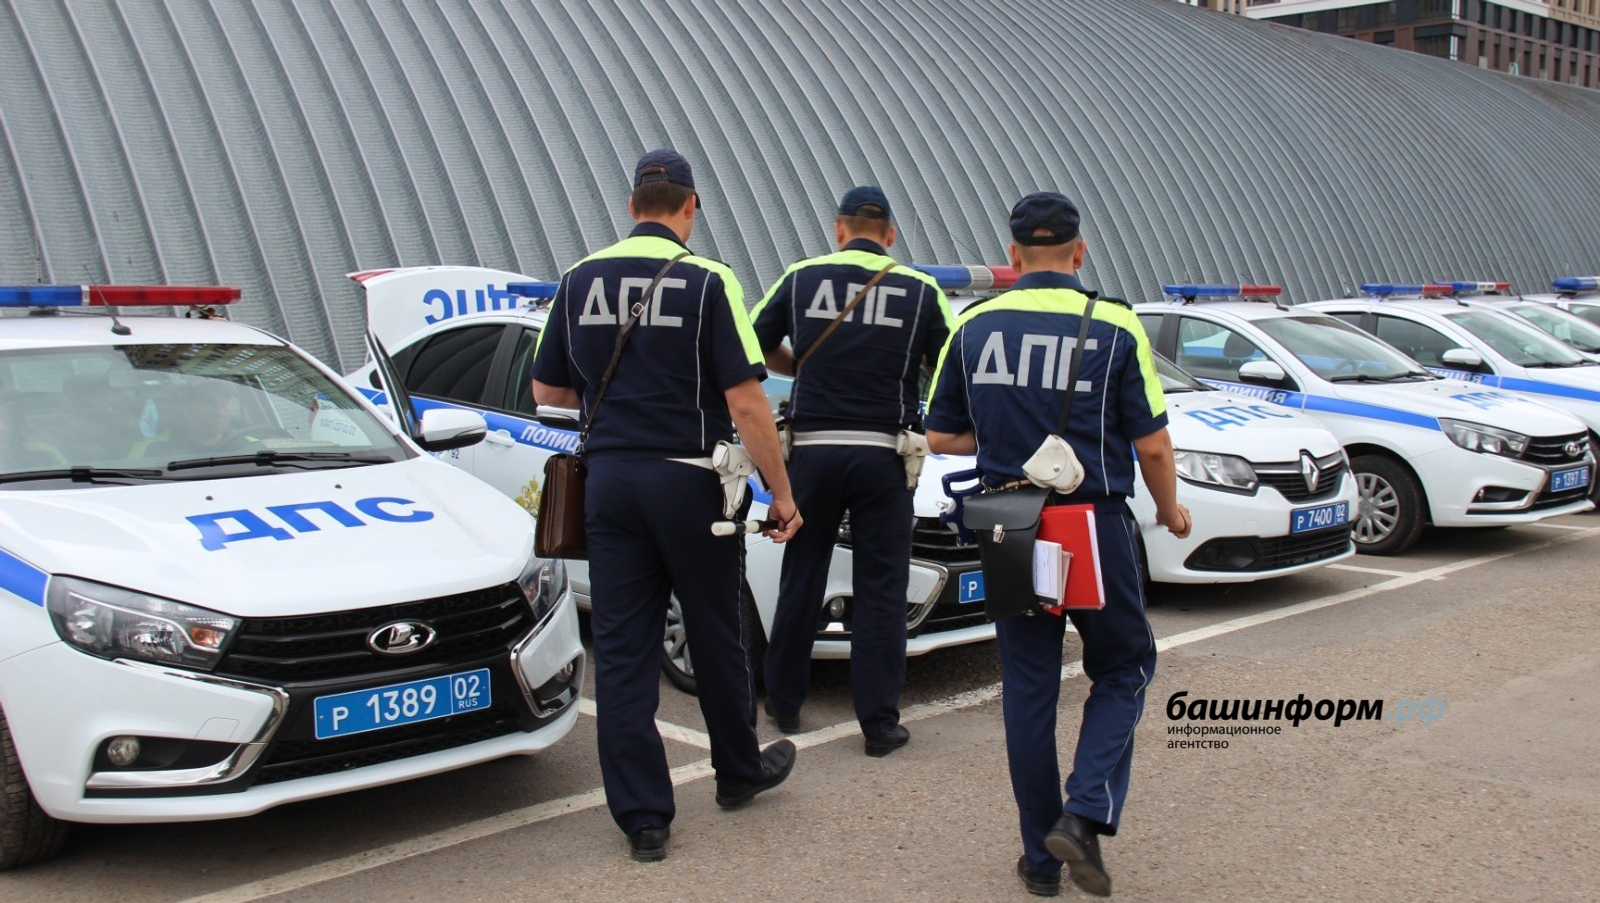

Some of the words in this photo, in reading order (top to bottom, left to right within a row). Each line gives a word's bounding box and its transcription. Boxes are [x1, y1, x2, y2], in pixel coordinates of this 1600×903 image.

[578, 277, 687, 328] ДПС
[805, 279, 908, 328] ДПС
[972, 331, 1098, 392] ДПС
[1183, 405, 1294, 431] ДПС
[185, 496, 435, 552] ДПС
[1308, 507, 1333, 528] 7400
[366, 684, 437, 724] 1389
[454, 675, 480, 700] 02
[458, 698, 478, 709] RUS
